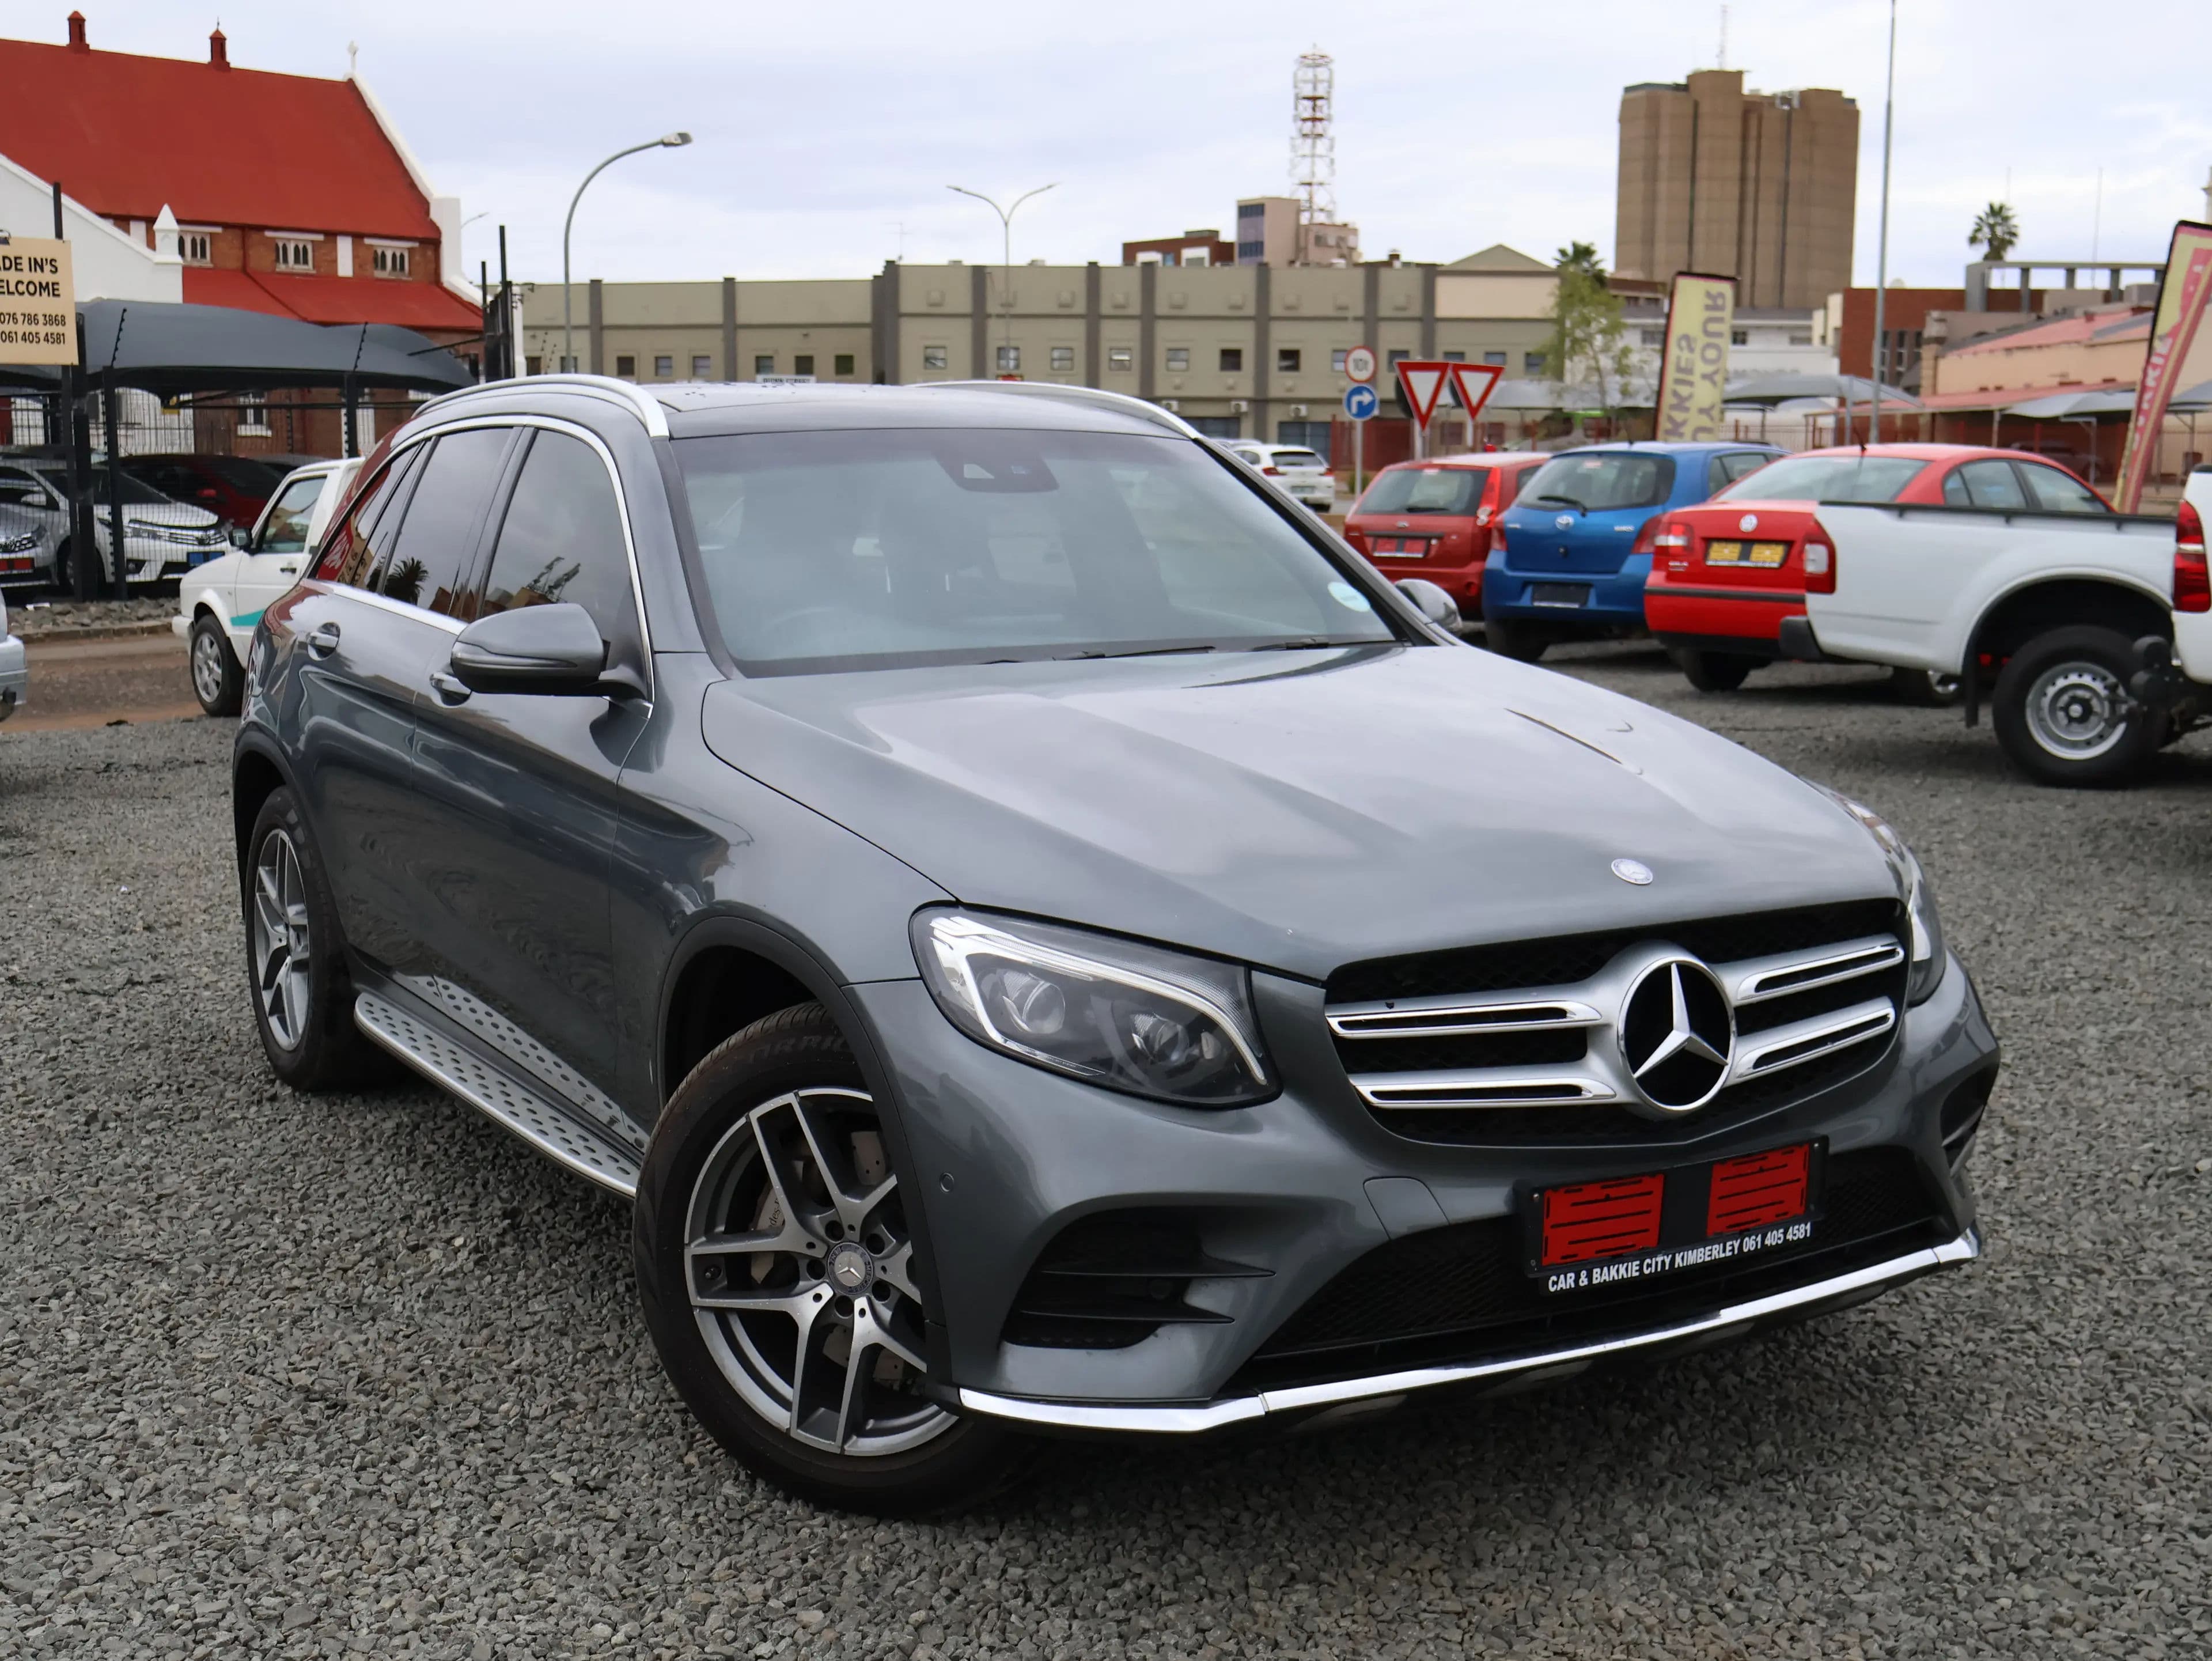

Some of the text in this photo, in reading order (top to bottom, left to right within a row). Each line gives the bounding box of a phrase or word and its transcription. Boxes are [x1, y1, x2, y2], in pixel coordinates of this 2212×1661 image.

[0, 256, 58, 274] DE IN'S
[0, 312, 66, 327] 076 786 3868
[1, 330, 66, 345] 061 405 4581
[1548, 1221, 1812, 1292] CAR & BAKKIE CITY KIMBERLEY 061 405 4581
